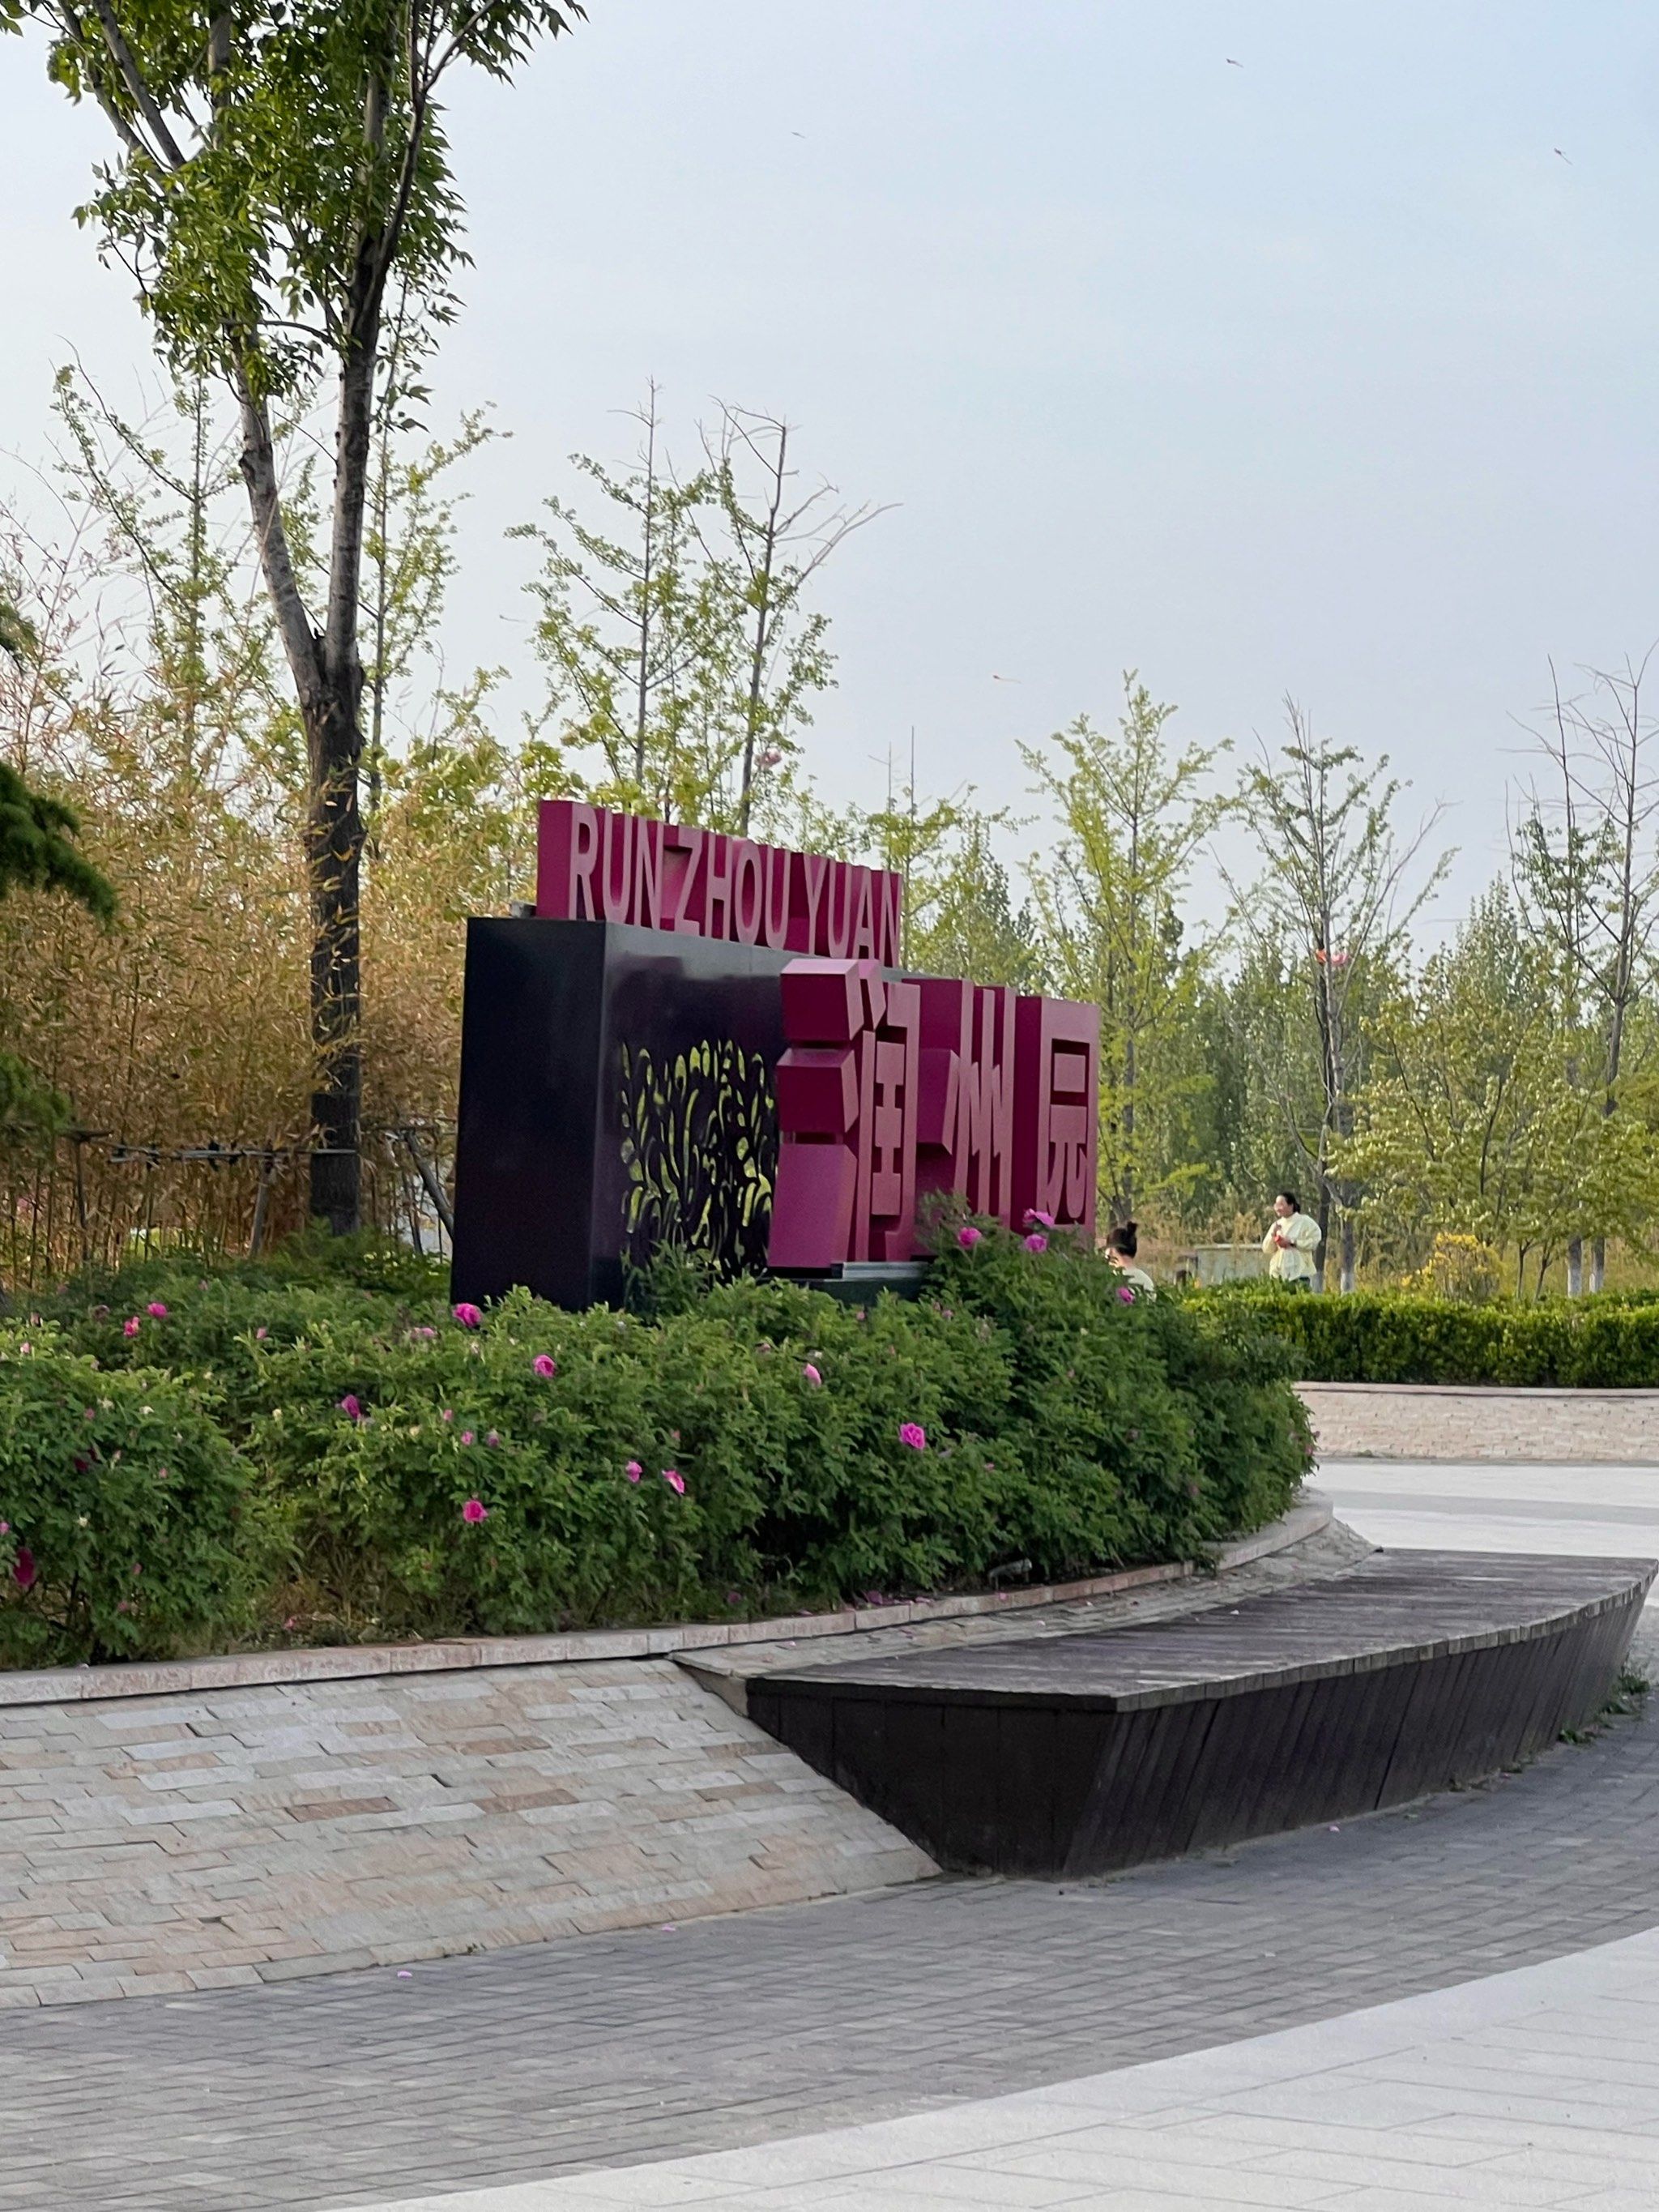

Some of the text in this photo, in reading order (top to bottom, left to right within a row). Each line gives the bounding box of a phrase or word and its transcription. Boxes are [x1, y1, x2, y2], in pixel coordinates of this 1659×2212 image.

[569, 801, 903, 967] RUN ZHOU YUAN
[839, 961, 1100, 1262] 润州园
